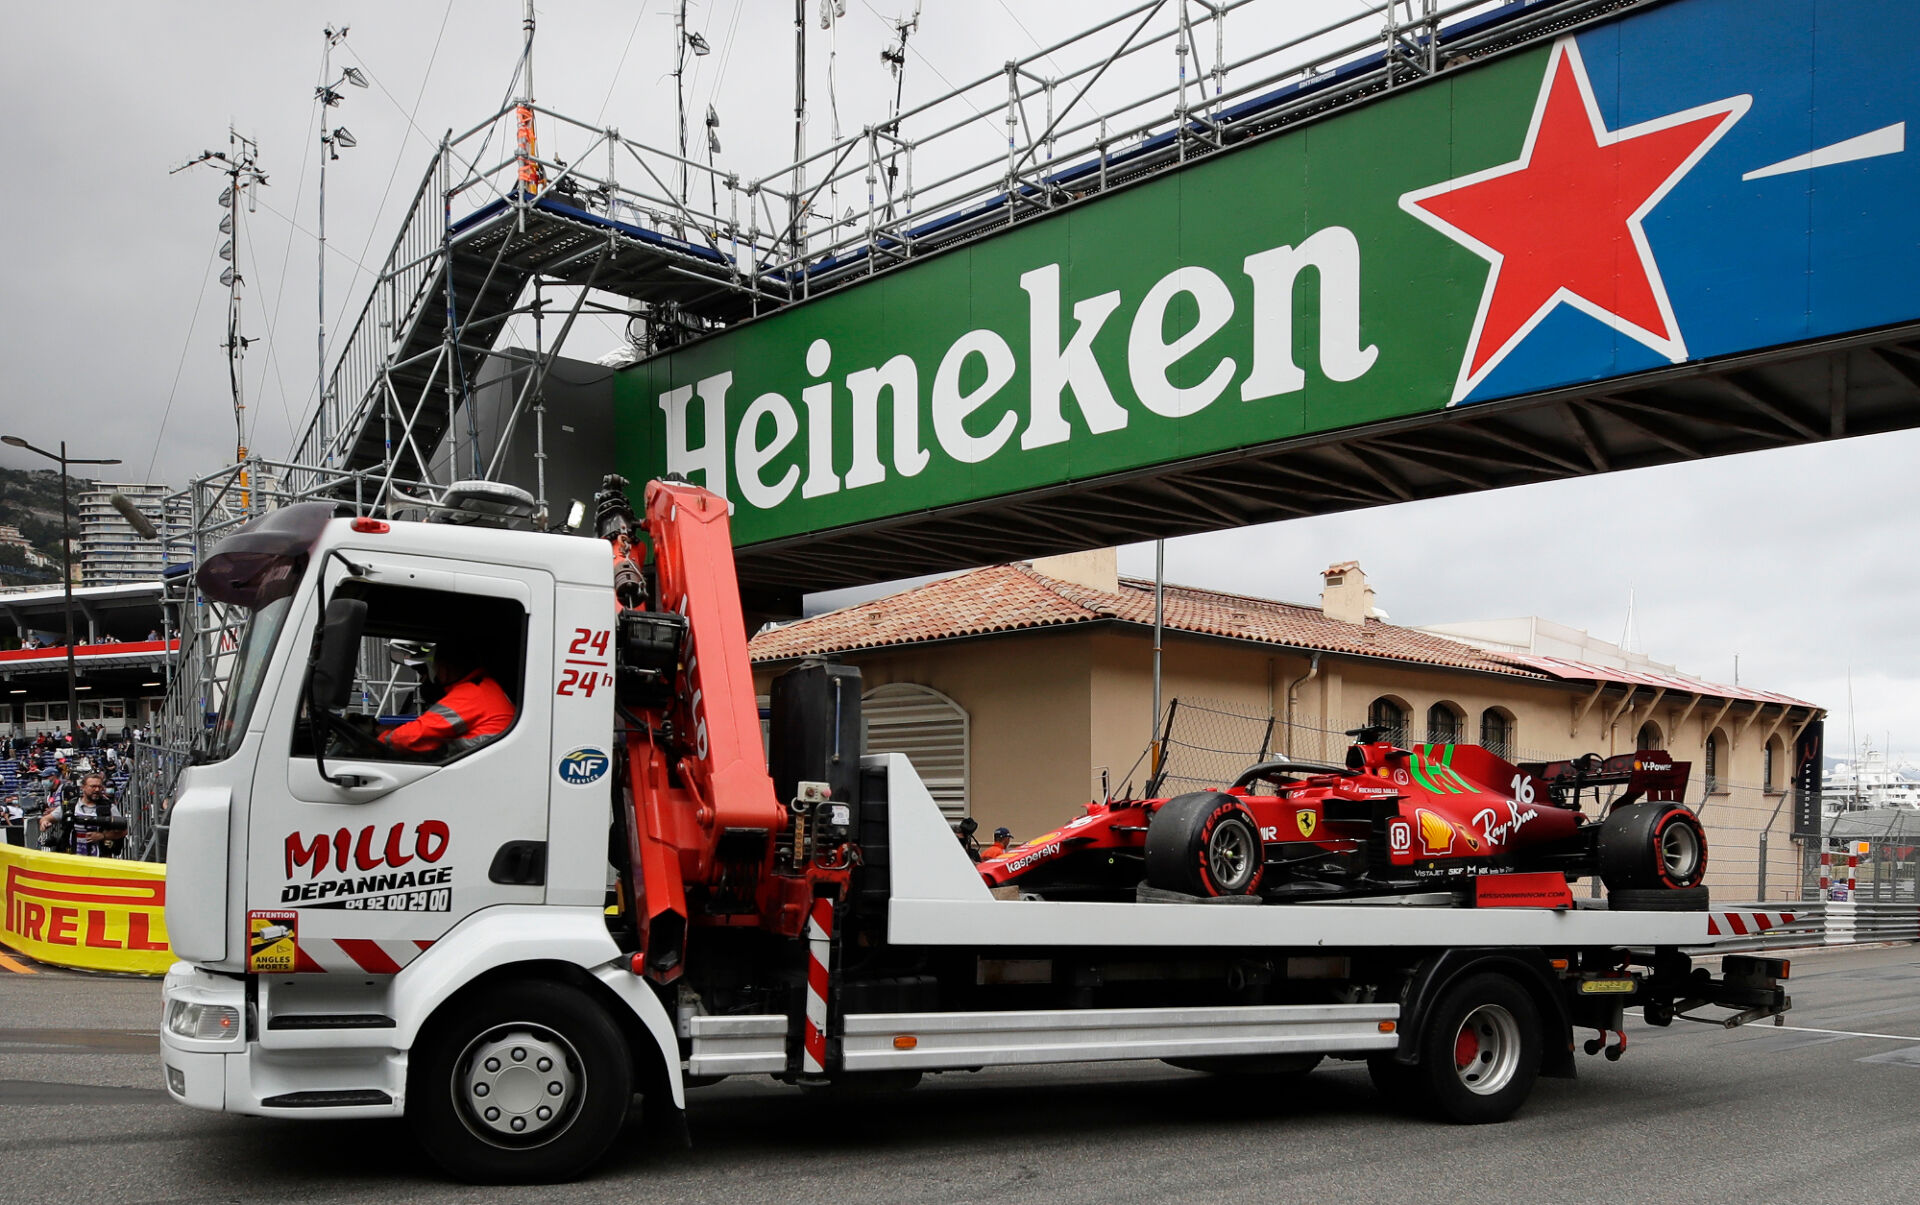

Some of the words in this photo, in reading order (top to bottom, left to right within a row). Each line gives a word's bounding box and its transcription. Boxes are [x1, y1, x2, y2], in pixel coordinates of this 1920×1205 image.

[659, 225, 1380, 516] Heineken
[568, 628, 611, 657] 24
[569, 759, 603, 777] NF
[1511, 774, 1535, 804] 16
[284, 819, 450, 881] MILLO
[1006, 842, 1061, 874] kaspersky
[281, 866, 454, 903] DEPANNAGE
[1447, 867, 1464, 876] SKF
[5, 865, 169, 951] PIRELL
[345, 899, 365, 910] 04
[367, 898, 384, 910] 92
[387, 895, 407, 911] 00
[408, 892, 427, 912] 29
[428, 888, 449, 912] 00
[251, 911, 296, 919] ATTENTION
[255, 955, 291, 964] ANGLES
